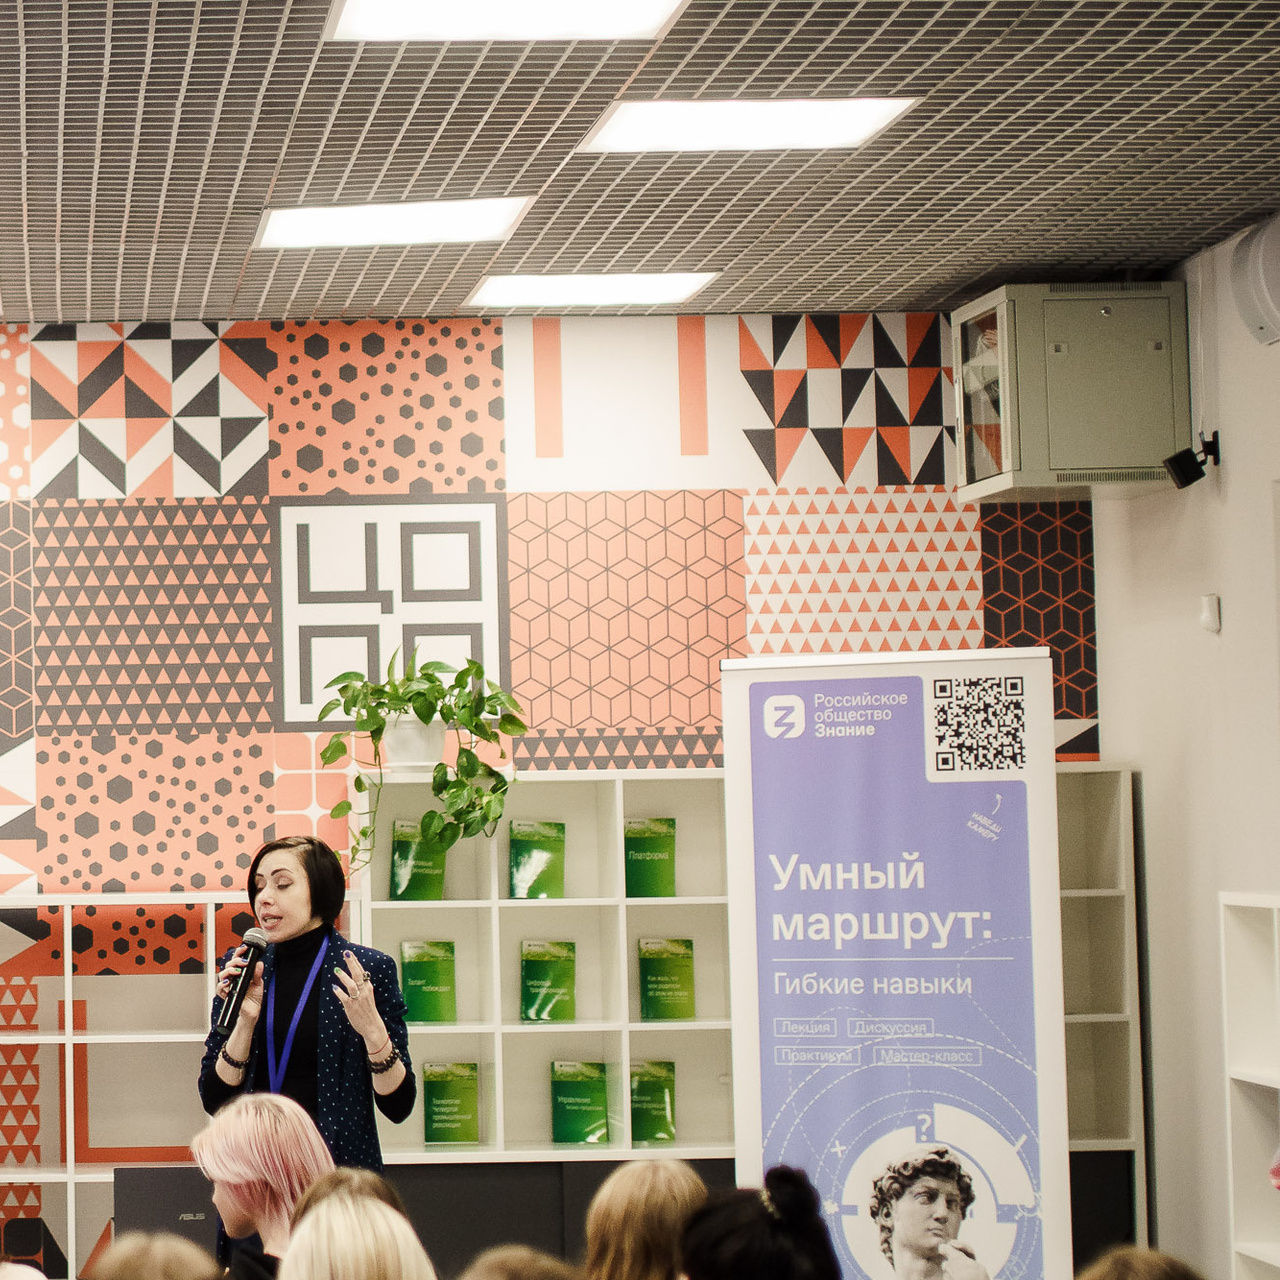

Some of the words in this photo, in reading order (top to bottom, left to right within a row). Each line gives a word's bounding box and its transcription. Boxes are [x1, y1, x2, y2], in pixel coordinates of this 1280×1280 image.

[814, 691, 908, 708] Российское
[814, 708, 892, 723] общество
[814, 723, 876, 737] Знание
[972, 811, 1003, 833] НАВЕДИ
[967, 820, 999, 842] КАМЕРУ
[628, 851, 669, 860] Платформа
[769, 851, 925, 890] Умный
[772, 911, 992, 950] маршрут:
[774, 971, 866, 995] Гибкие
[873, 976, 973, 995] навыки
[781, 1020, 831, 1036] Лекция
[853, 1020, 928, 1039] Дискуссия
[781, 1048, 853, 1063] Практикум
[880, 1049, 974, 1064] Мастер-класс
[178, 1213, 206, 1221] ASUS
